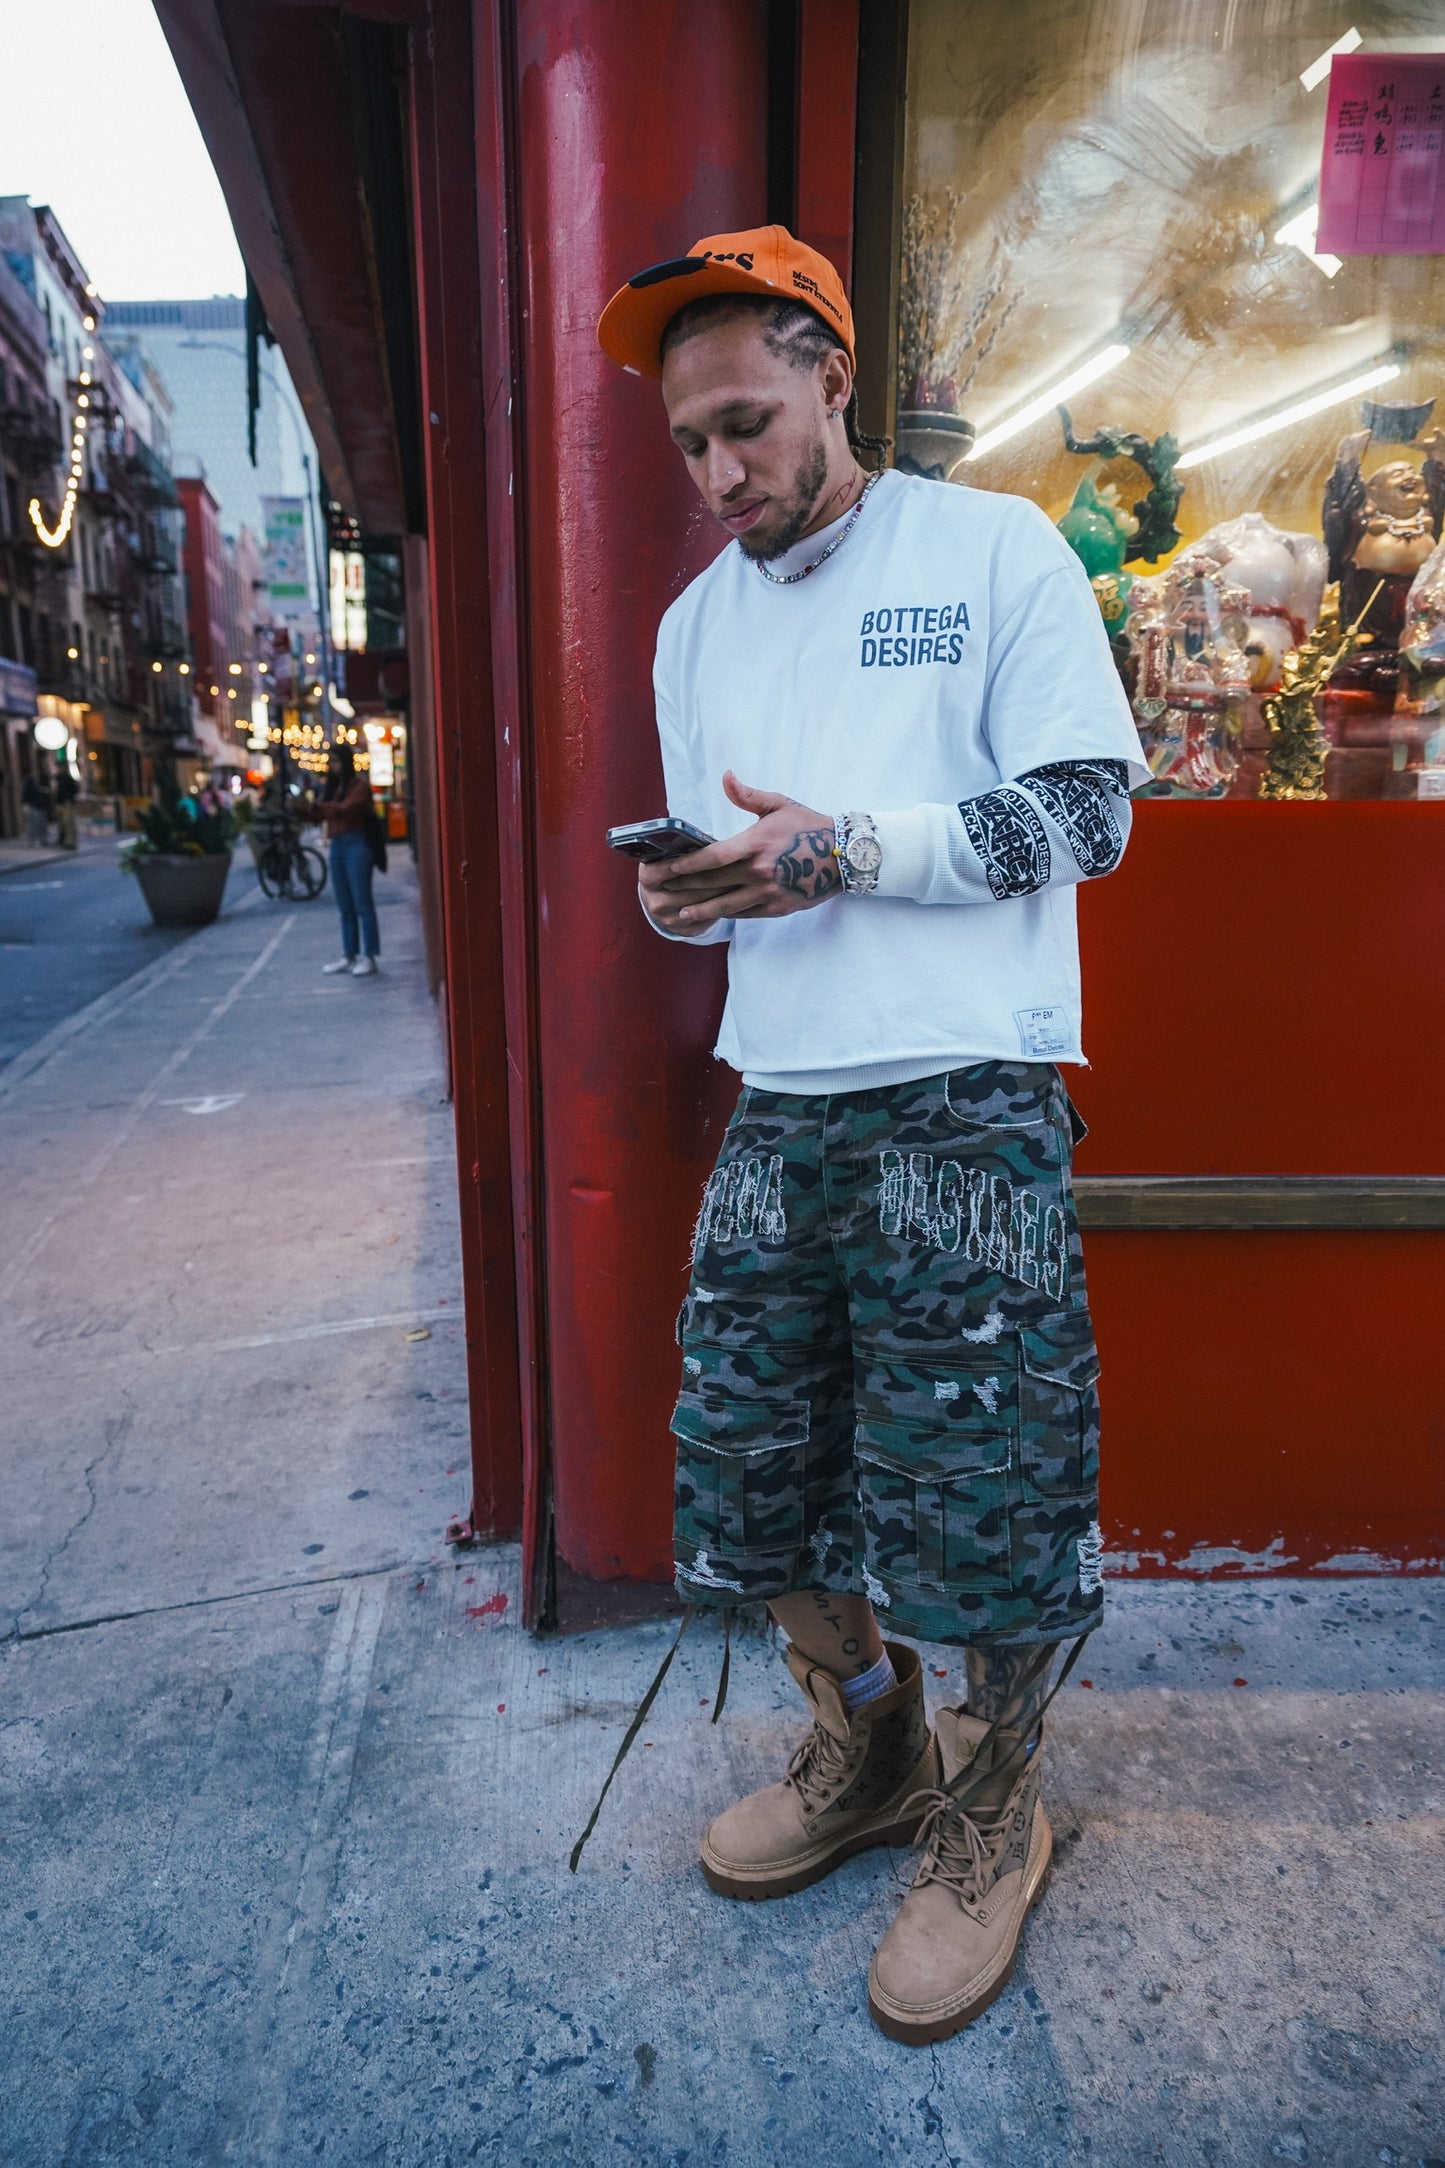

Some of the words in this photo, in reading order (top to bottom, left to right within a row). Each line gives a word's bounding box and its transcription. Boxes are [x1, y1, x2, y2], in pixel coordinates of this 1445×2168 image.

[860, 602, 971, 636] BOTTEGA
[860, 633, 964, 667] DESIRES
[997, 790, 1045, 840] BOTTEGA
[973, 837, 991, 866] THE
[1049, 805, 1071, 834] THE
[1069, 833, 1093, 872] WORLD
